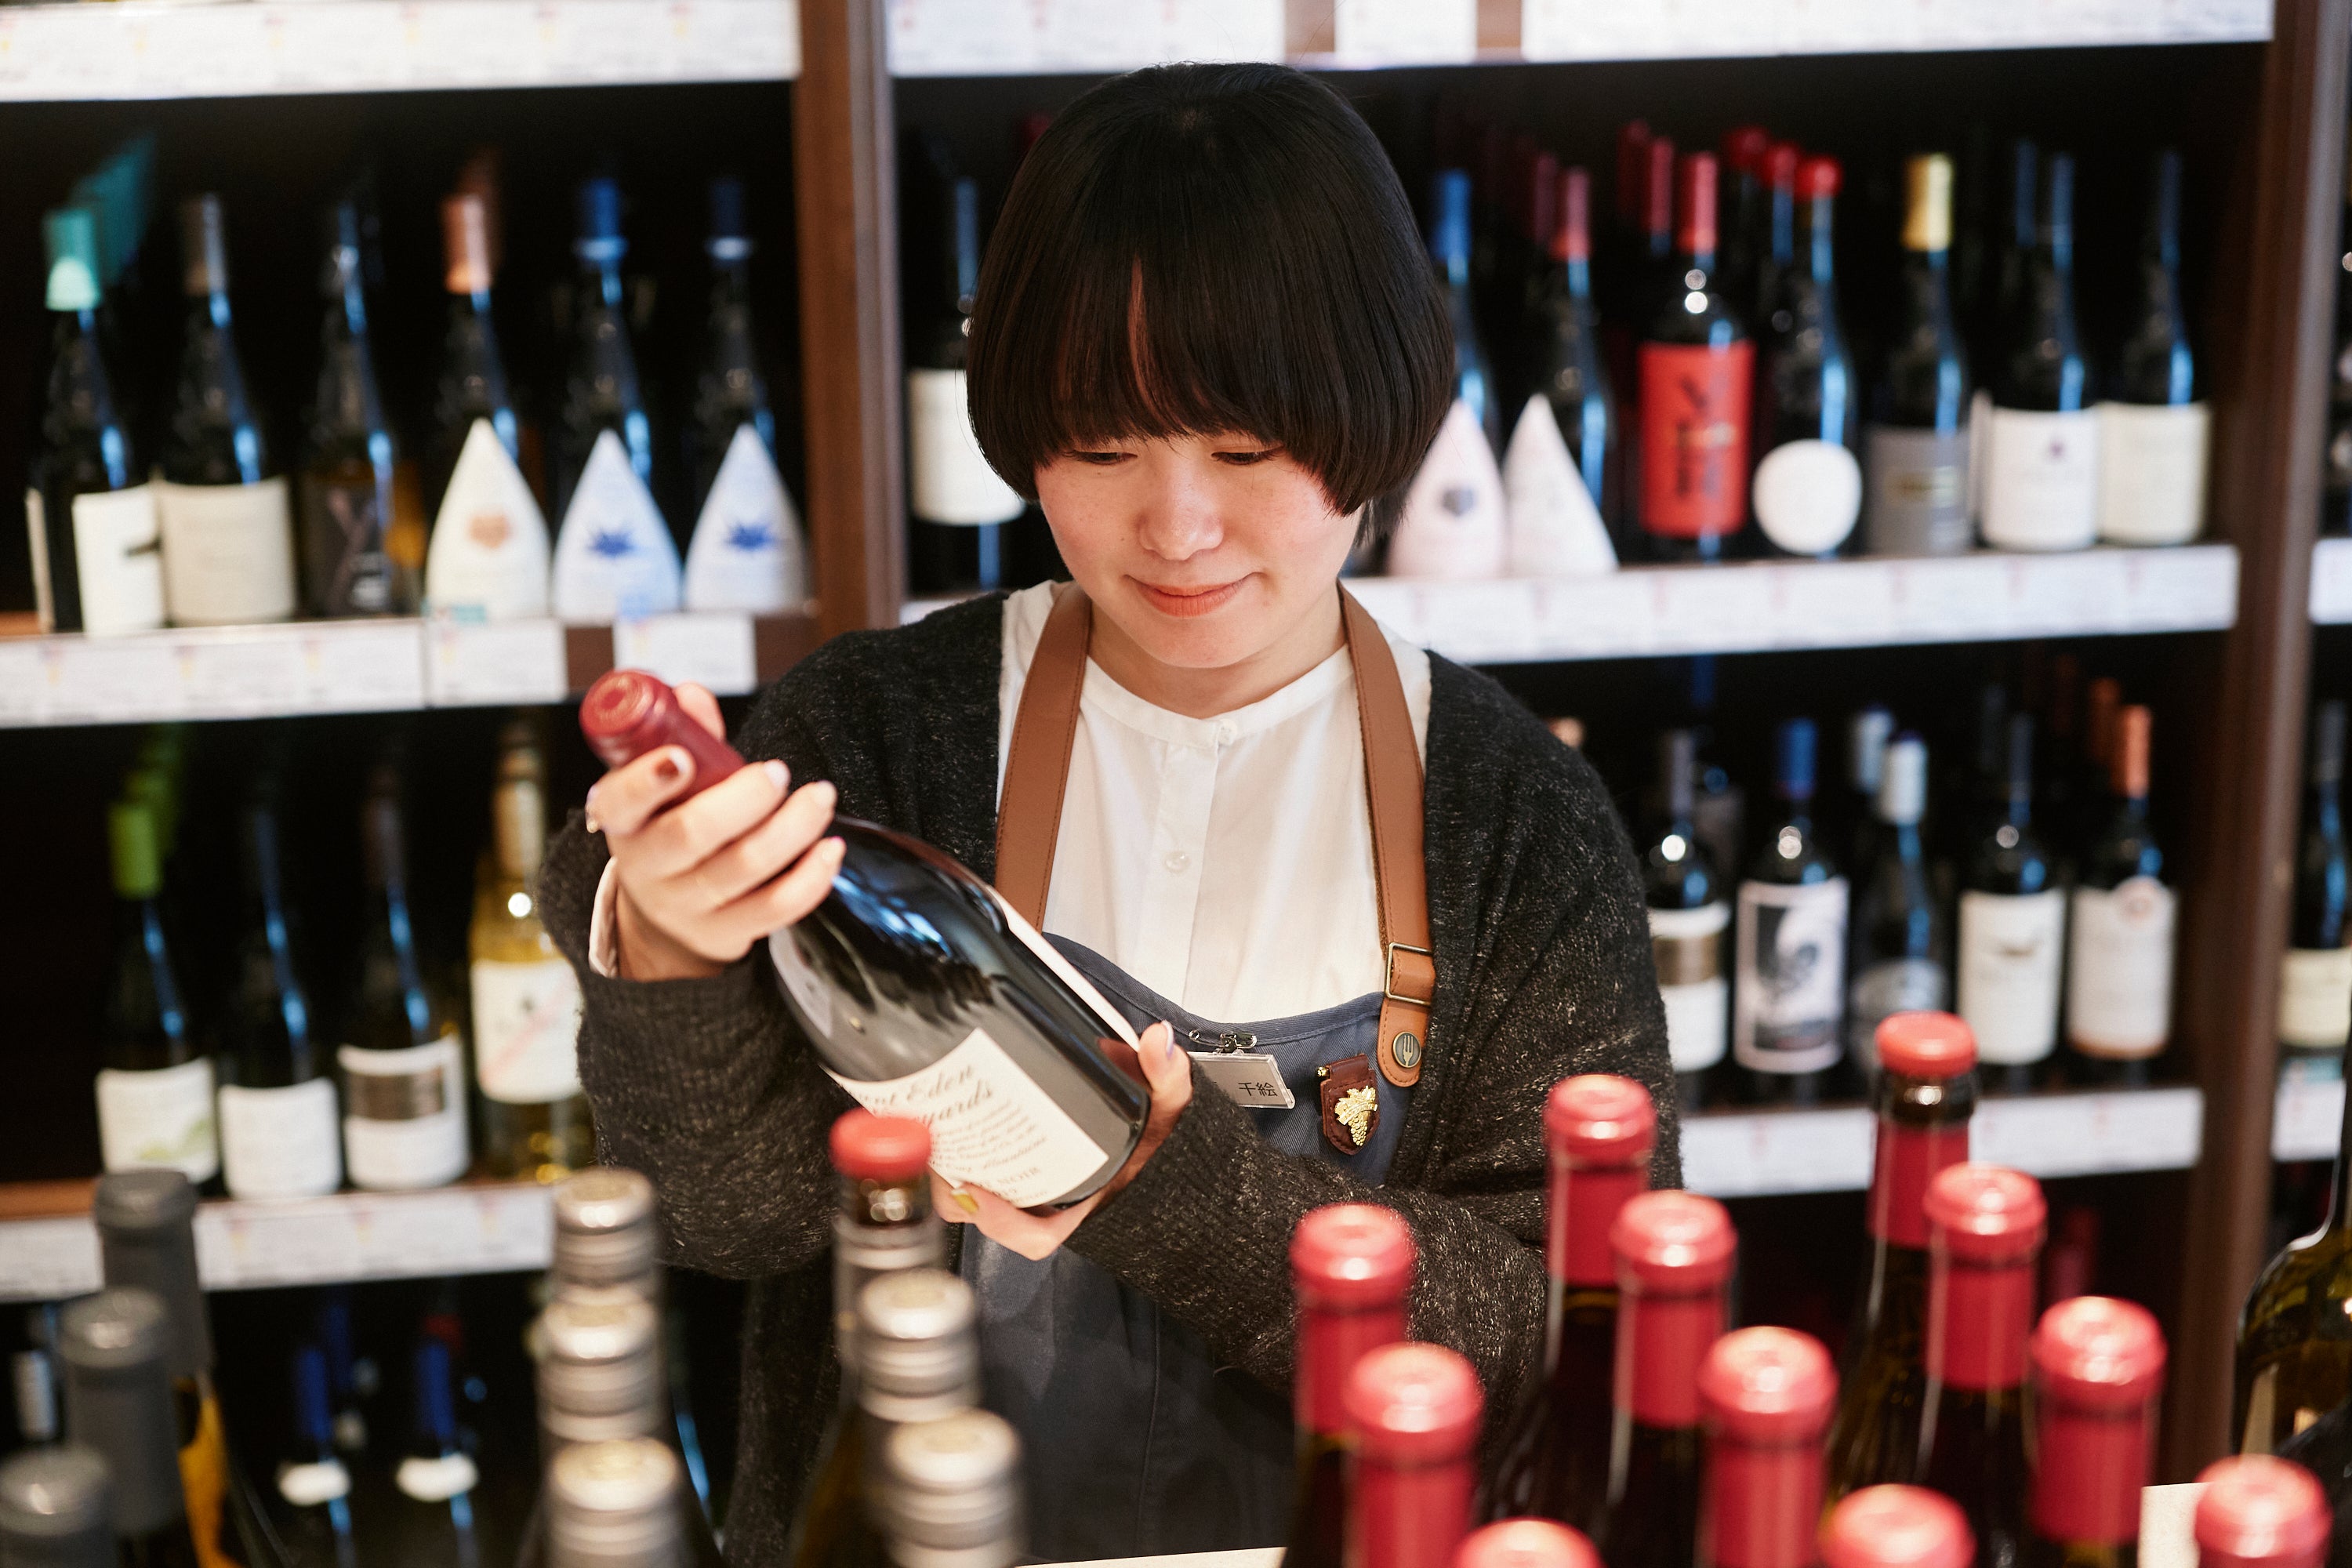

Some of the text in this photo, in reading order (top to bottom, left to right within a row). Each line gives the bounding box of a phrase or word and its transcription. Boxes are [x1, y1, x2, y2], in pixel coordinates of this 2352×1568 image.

[906, 1065, 973, 1102] Eden
[1238, 1082, 1278, 1097] 千絵
[923, 1078, 993, 1129] yards
